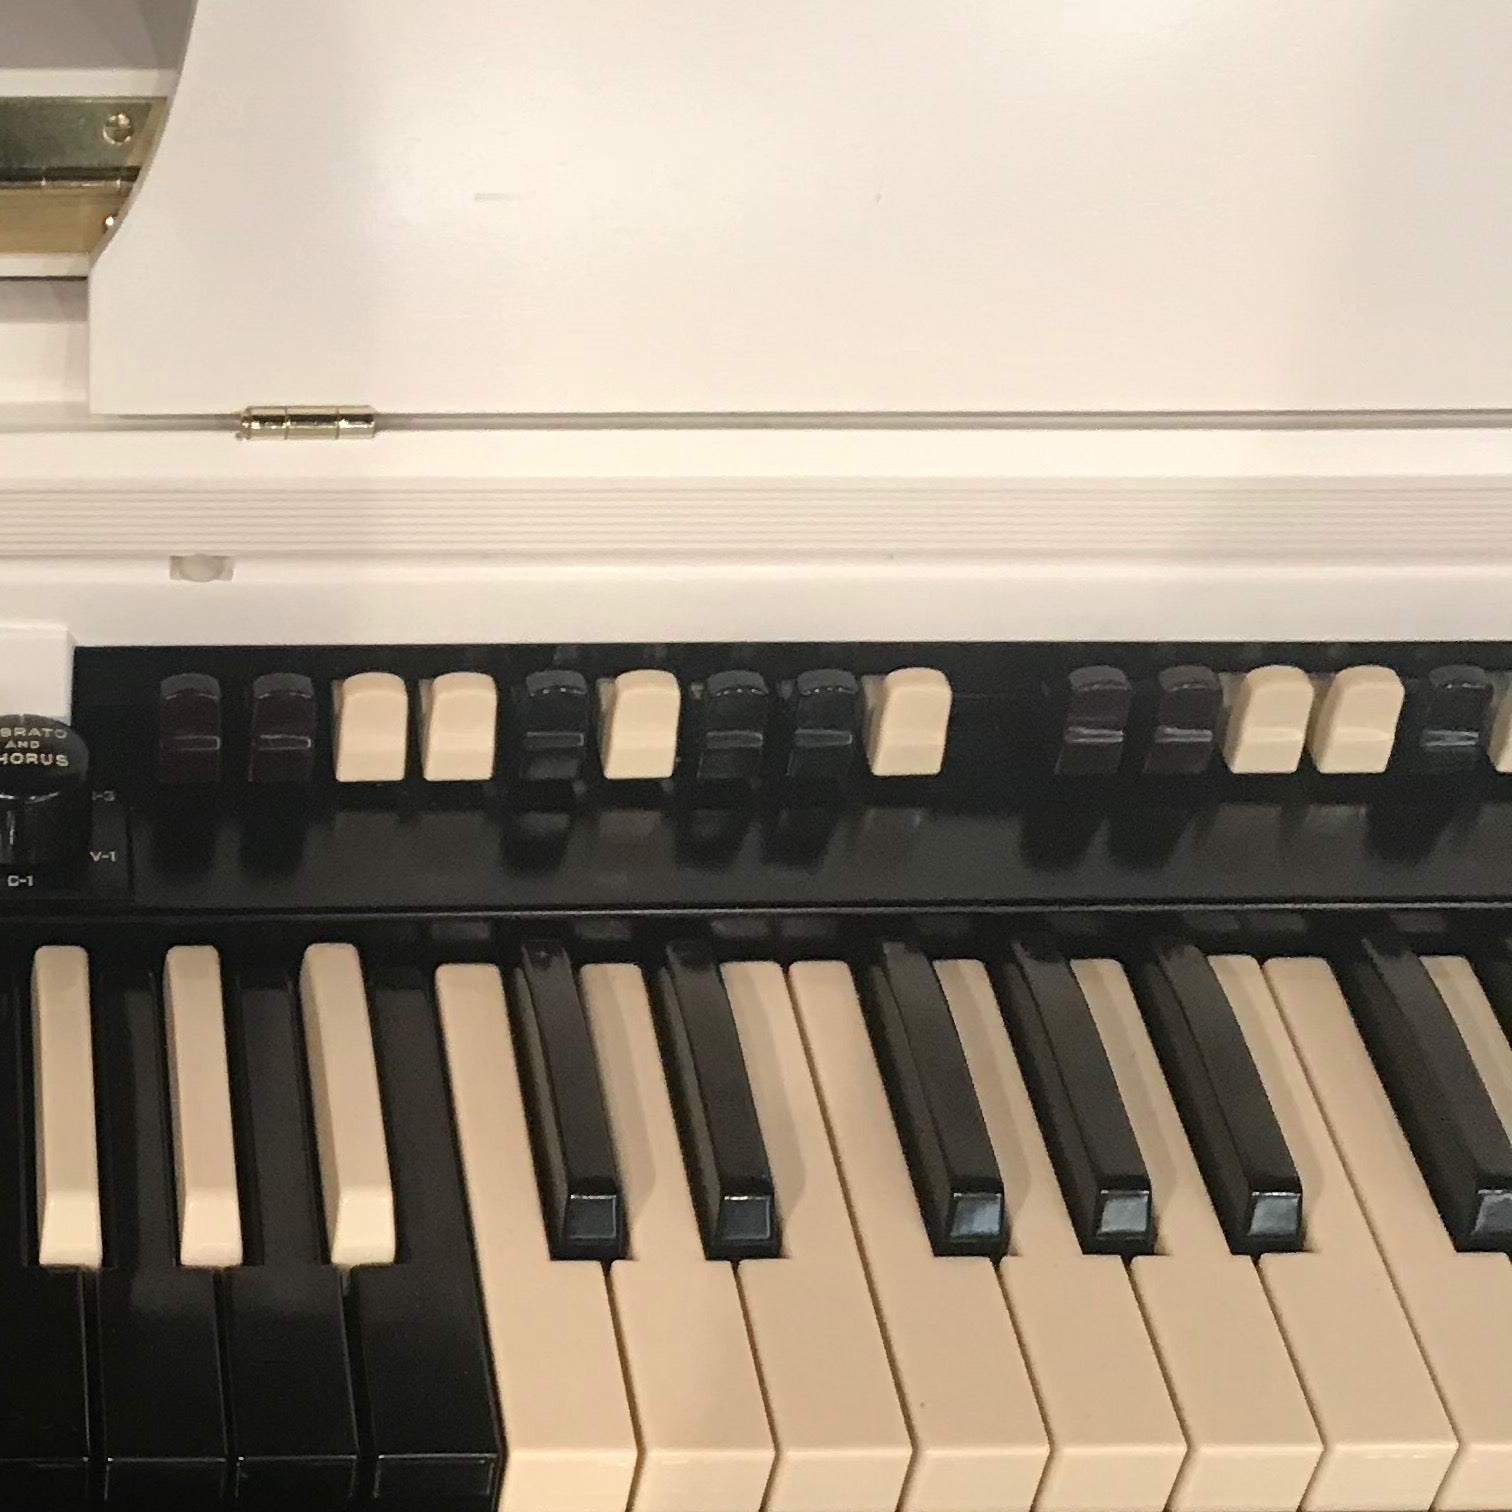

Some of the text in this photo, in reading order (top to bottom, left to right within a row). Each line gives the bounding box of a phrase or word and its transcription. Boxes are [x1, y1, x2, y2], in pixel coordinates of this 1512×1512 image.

[5, 740, 40, 749] AND
[90, 850, 118, 863] V-1
[7, 875, 34, 887] C-1
